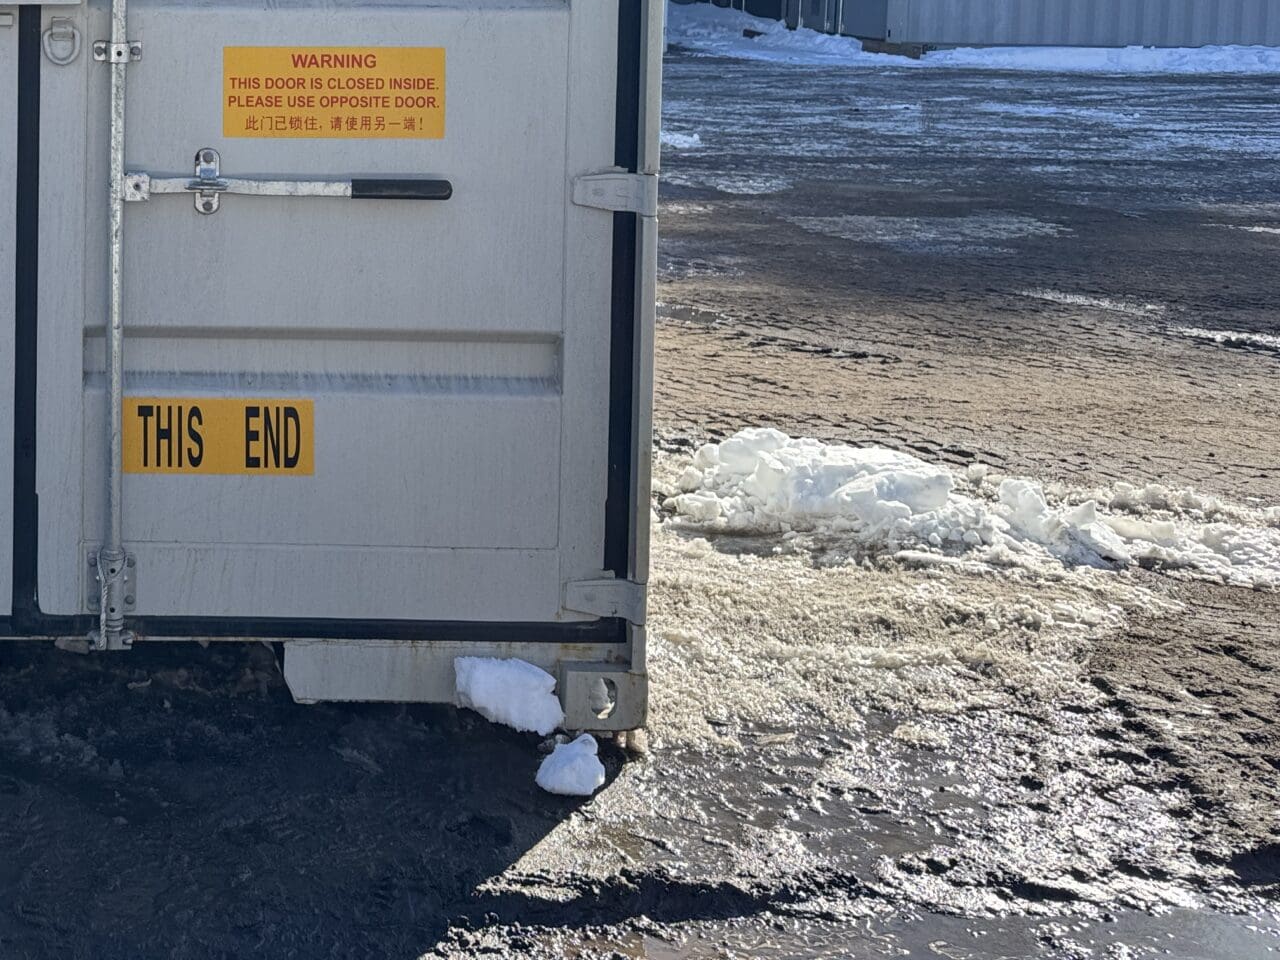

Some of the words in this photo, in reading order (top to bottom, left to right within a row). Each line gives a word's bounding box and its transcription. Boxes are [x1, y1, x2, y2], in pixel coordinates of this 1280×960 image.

[291, 53, 377, 69] WARNING
[229, 77, 261, 90] THIS
[265, 77, 306, 90] DOOR
[310, 77, 323, 90] IS
[327, 77, 384, 91] CLOSED
[389, 78, 439, 91] INSIDE.
[228, 96, 282, 108] PLEASE
[287, 96, 315, 108] USE
[319, 96, 390, 108] OPPOSITE
[395, 96, 440, 109] DOOR.
[137, 405, 204, 468] THIS
[245, 406, 301, 469] END
